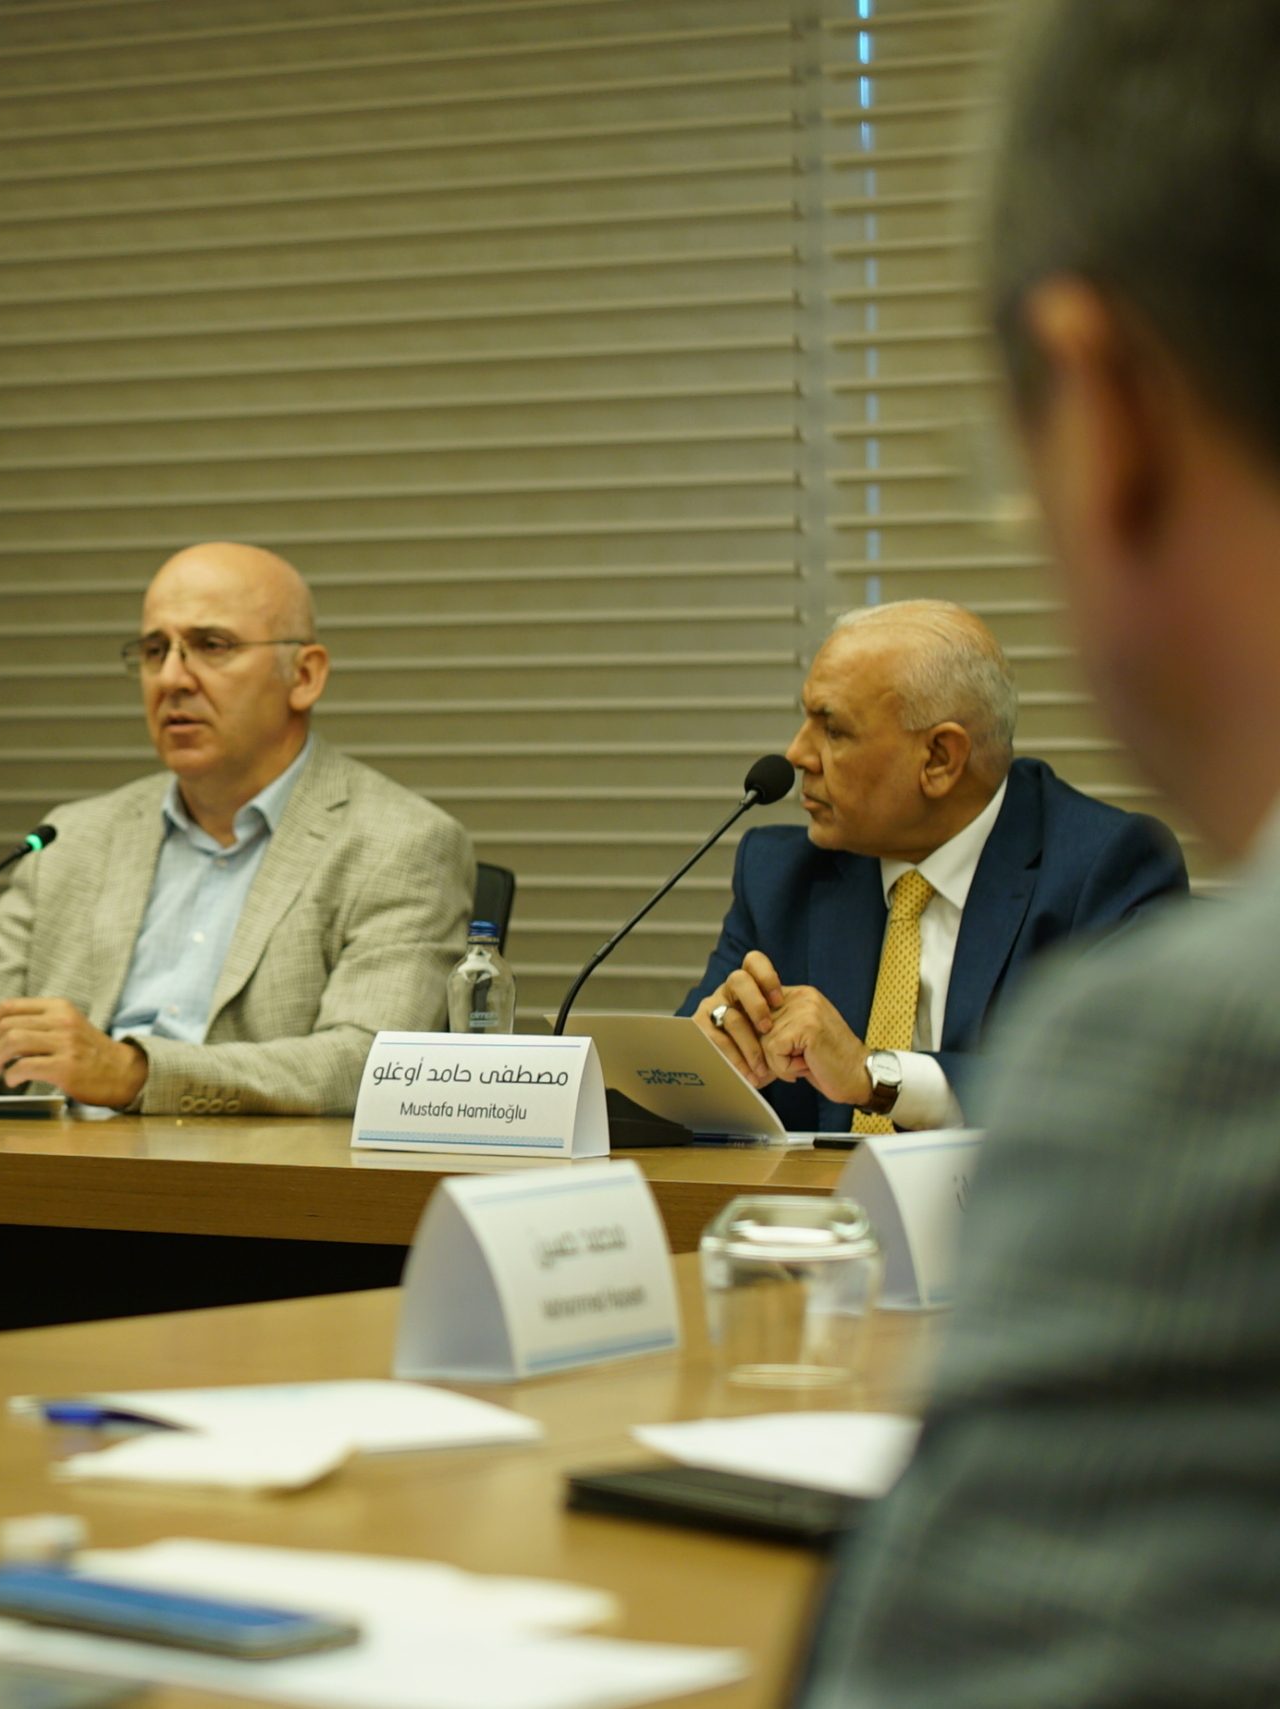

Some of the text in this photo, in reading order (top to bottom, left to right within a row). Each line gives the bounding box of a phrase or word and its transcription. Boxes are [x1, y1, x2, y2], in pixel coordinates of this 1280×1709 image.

[372, 1057, 569, 1087] مصطفى حامد أوغلو
[399, 1101, 528, 1124] Mustafa Hamitoğlu
